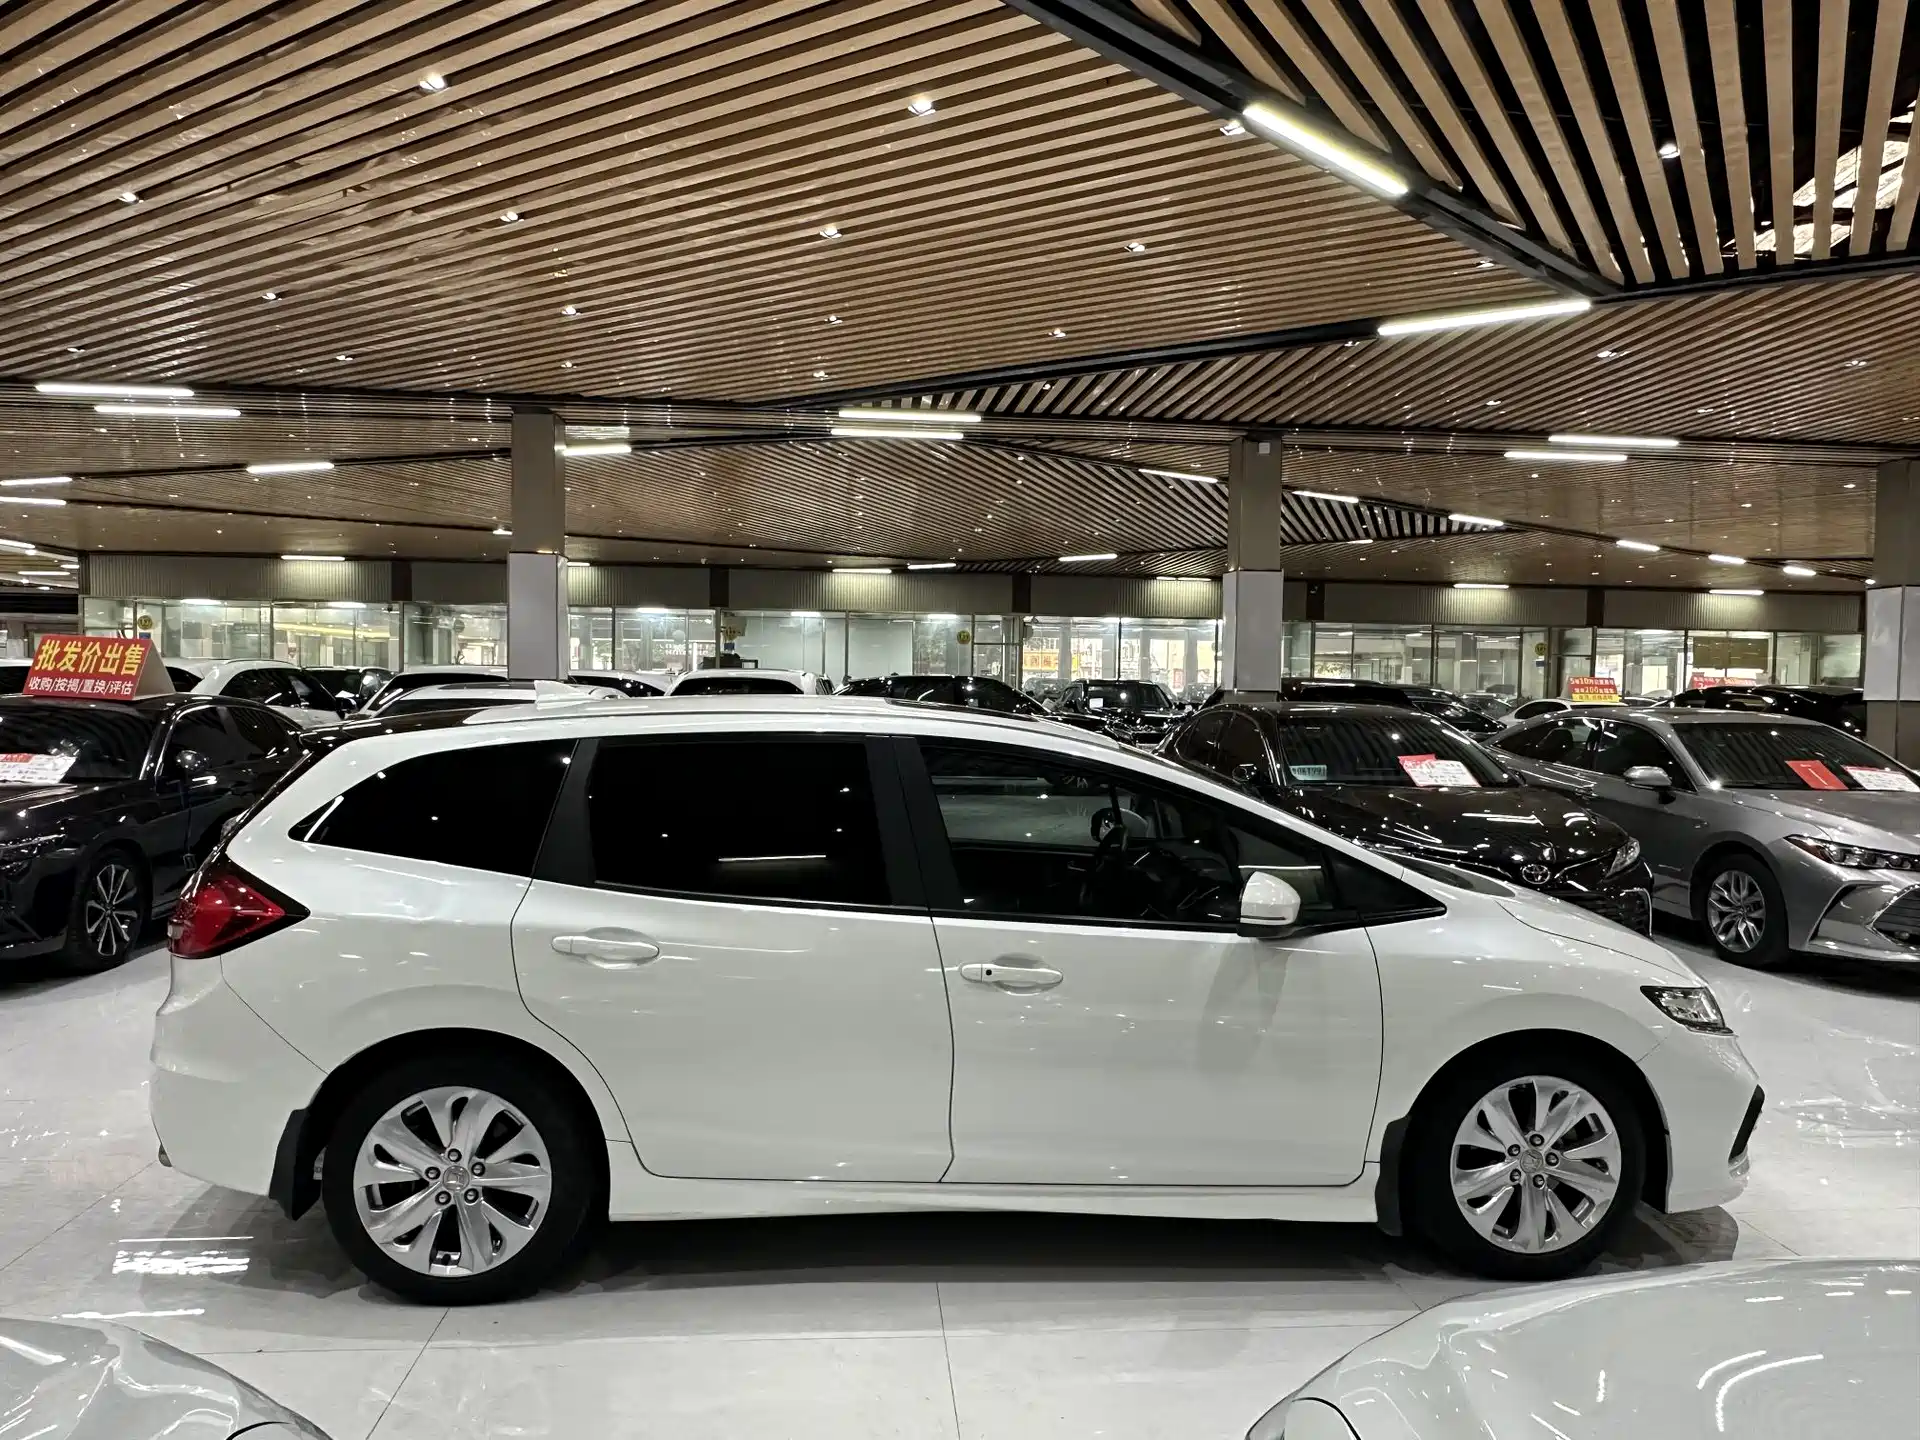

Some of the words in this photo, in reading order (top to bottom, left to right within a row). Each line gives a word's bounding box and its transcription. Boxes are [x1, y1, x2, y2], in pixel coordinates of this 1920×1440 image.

[35, 639, 145, 676] 批发价出售
[28, 676, 134, 695] 收购/按揭/置换/评估
